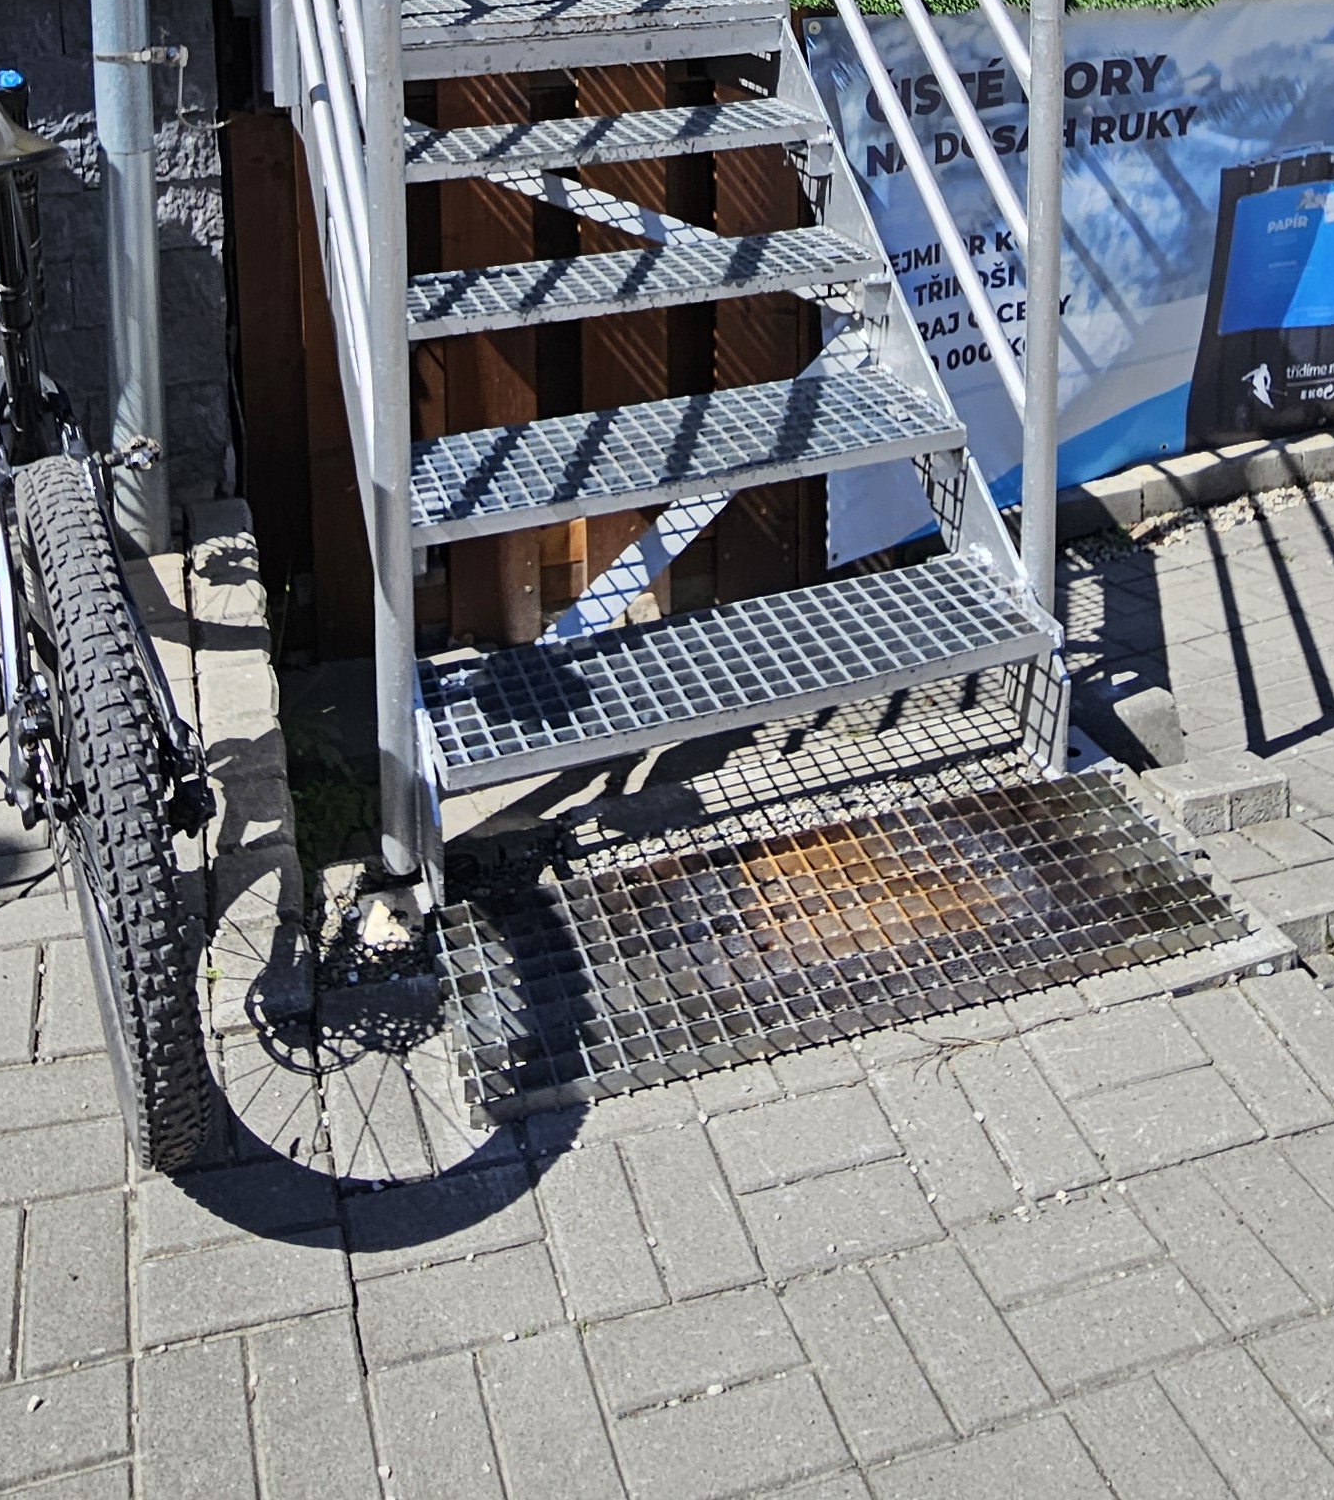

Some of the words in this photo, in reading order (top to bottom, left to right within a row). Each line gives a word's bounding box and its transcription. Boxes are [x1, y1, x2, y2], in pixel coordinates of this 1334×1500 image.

[1022, 54, 1167, 102] ORY
[1090, 105, 1198, 146] RUKY
[1267, 214, 1309, 234] PAPÍR
[1286, 362, 1328, 379] třídíme
